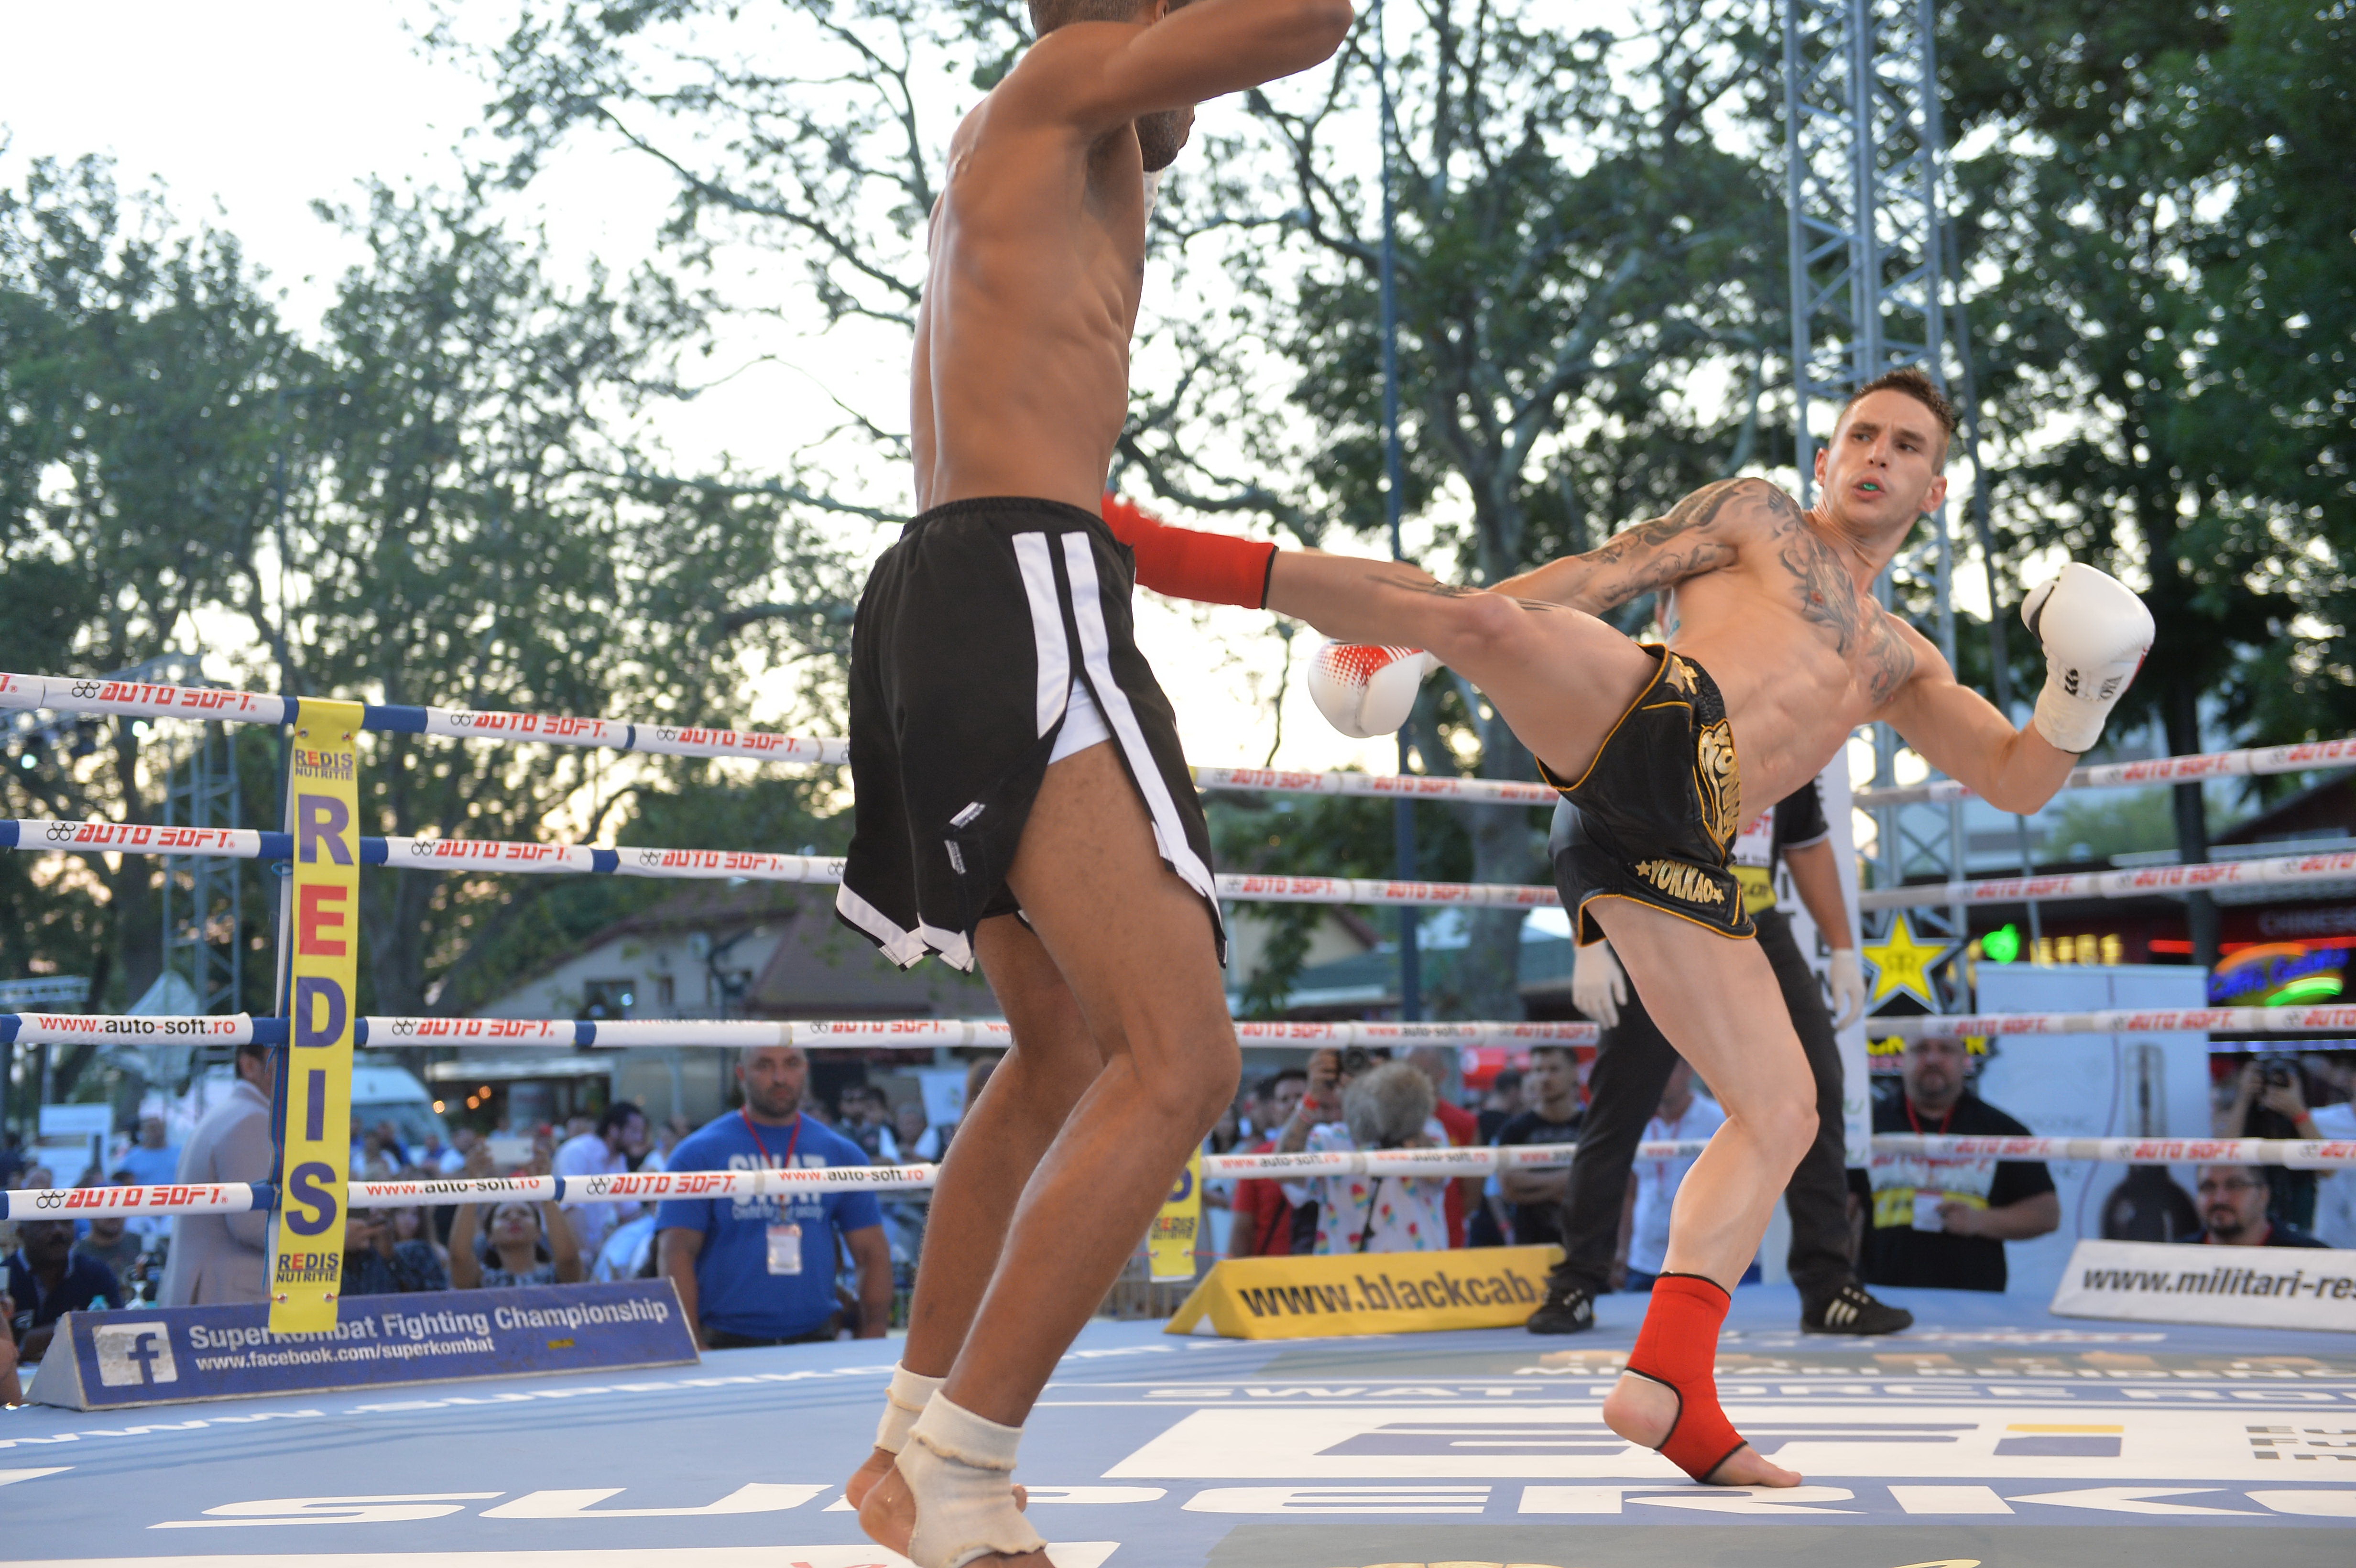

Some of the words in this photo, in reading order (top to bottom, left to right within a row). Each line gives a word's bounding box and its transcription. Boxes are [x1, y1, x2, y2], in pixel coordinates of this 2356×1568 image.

[98, 682, 175, 705] AUTO
[474, 712, 538, 732] AUTO
[678, 727, 737, 746] AUTO
[295, 749, 353, 767] REDIS
[295, 766, 353, 781] NUTRITIE
[74, 824, 153, 845] AUTO
[435, 839, 501, 858] AUTO
[661, 849, 720, 868] AUTO
[1649, 859, 1713, 903] YOKKAO
[38, 1016, 236, 1034] www.auto-soft.ro
[286, 794, 354, 1237] REDIS
[416, 1018, 482, 1036] AUTO
[778, 1165, 925, 1183] www.auto-soft.ro
[366, 1177, 540, 1196] www.auto-soft.ro
[610, 1175, 671, 1195] AUTO
[65, 1187, 144, 1209] AUTO
[278, 1253, 339, 1271] REDIS
[276, 1268, 338, 1283] NUTRITIE
[2083, 1266, 2356, 1300] www.militari-re
[1237, 1268, 1550, 1318] www.blackcab.
[382, 1310, 490, 1340] Fighting
[494, 1297, 669, 1330] Championship
[196, 1337, 495, 1371] www.facebook.com/superkombat
